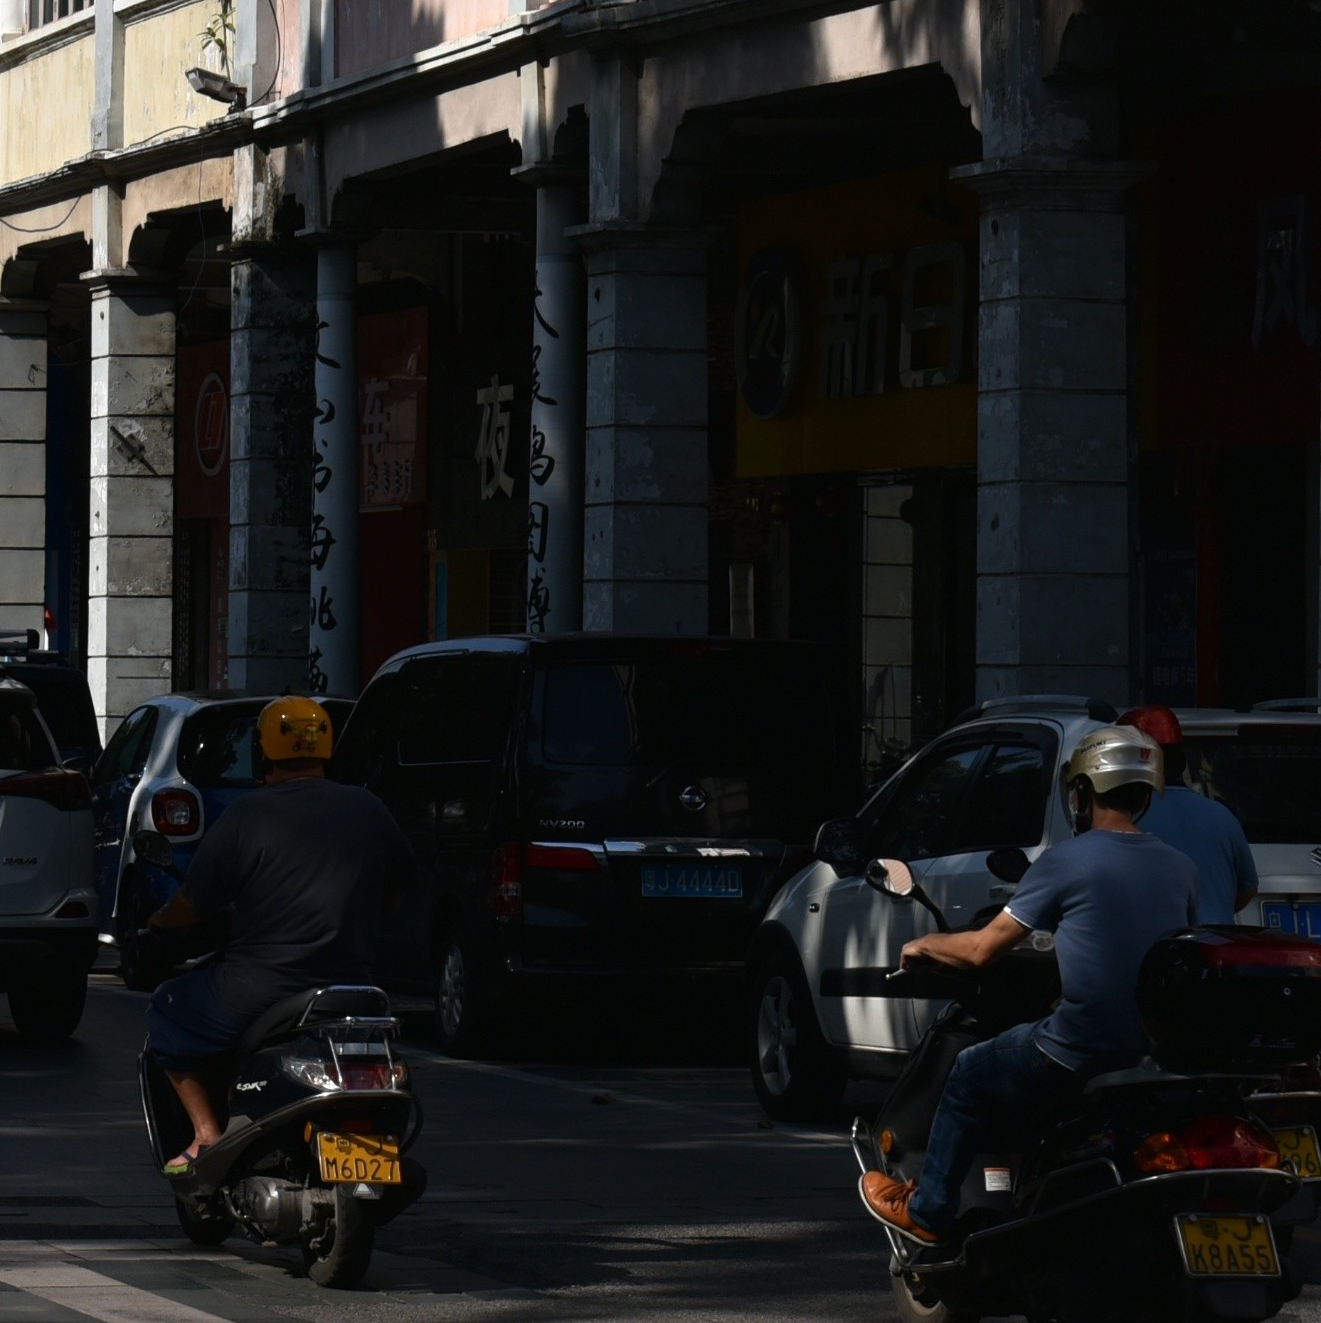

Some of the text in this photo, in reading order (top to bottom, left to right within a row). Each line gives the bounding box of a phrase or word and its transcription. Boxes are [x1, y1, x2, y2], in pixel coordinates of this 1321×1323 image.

[820, 243, 967, 398] 新日
[475, 374, 515, 500] 夜
[539, 819, 585, 829] NV200
[325, 1157, 394, 1181] M6D27
[1191, 1244, 1271, 1270] K8A55
